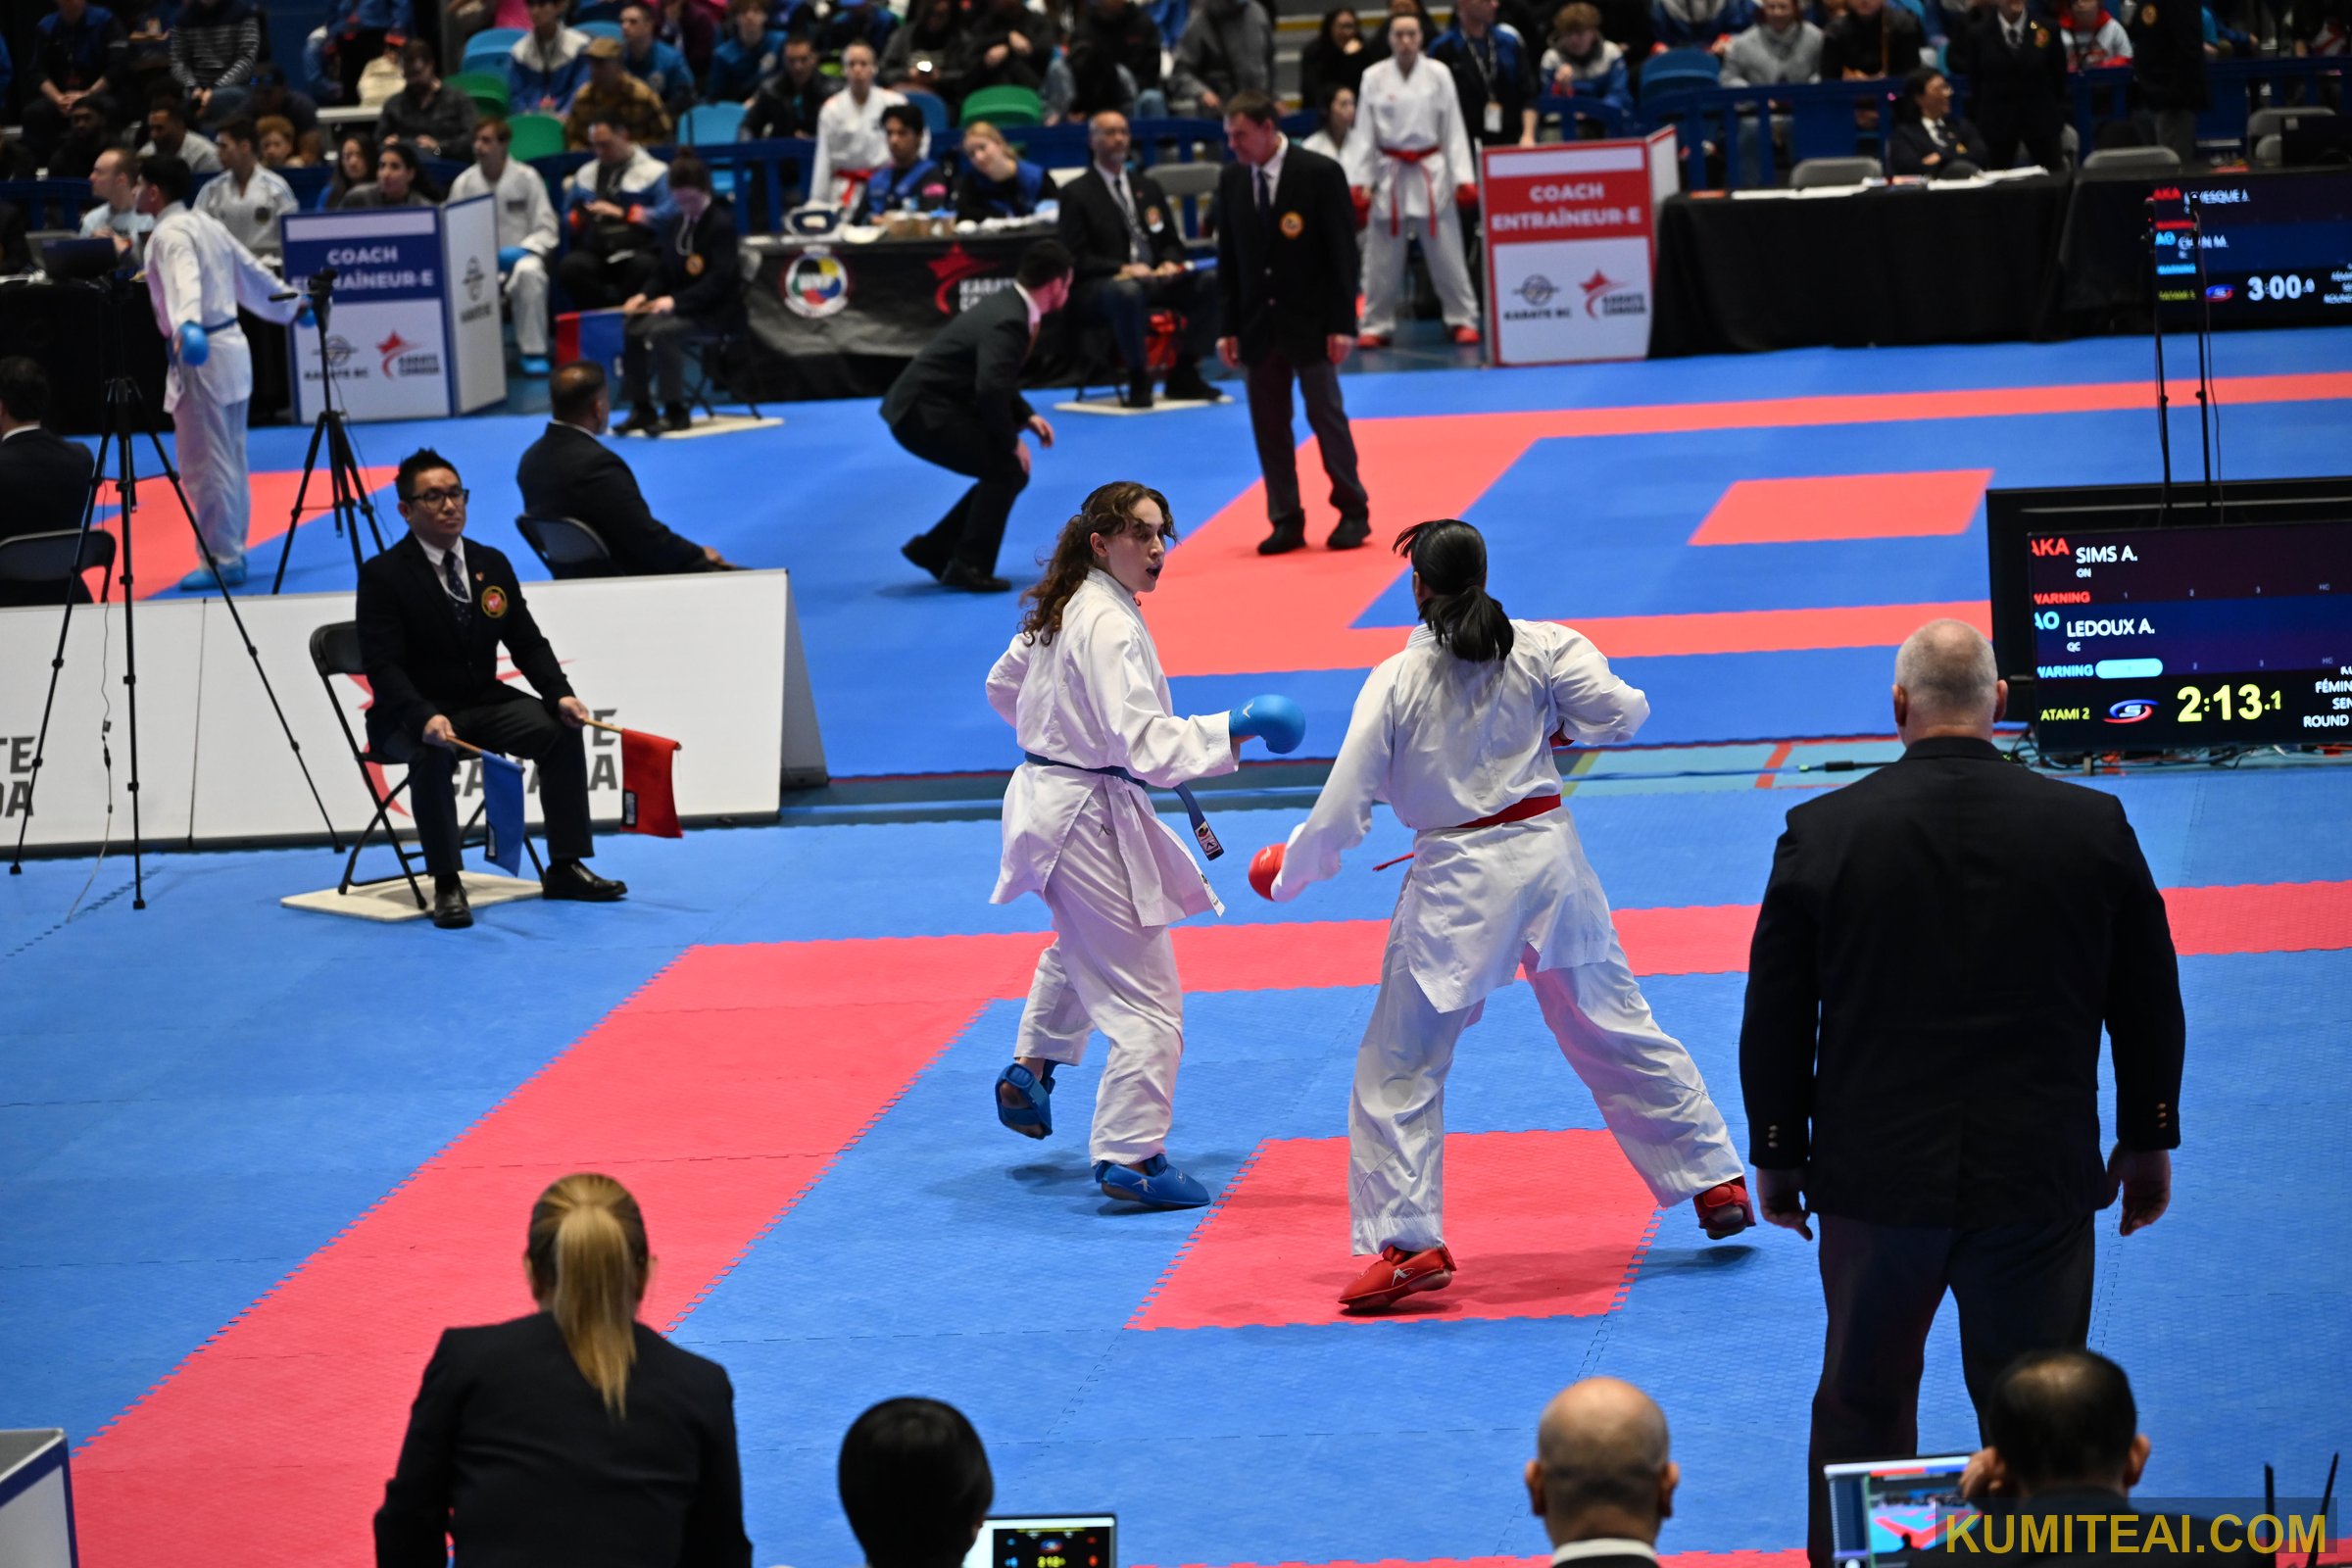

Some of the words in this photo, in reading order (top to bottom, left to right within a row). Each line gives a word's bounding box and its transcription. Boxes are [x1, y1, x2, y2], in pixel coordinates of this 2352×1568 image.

[1530, 183, 1603, 202] COACH
[2155, 231, 2176, 245] AO
[326, 246, 398, 266] COACH
[2076, 546, 2118, 564] SIMS
[2121, 545, 2138, 562] A.
[2076, 567, 2092, 578] ON
[2066, 618, 2135, 638] LEDOUX
[2137, 617, 2156, 635] A.
[2066, 641, 2082, 653] QC
[2177, 683, 2282, 722] 2:13.1
[2040, 708, 2080, 721] ATAMI
[2082, 708, 2091, 720] 2
[2303, 713, 2350, 728] ROUND
